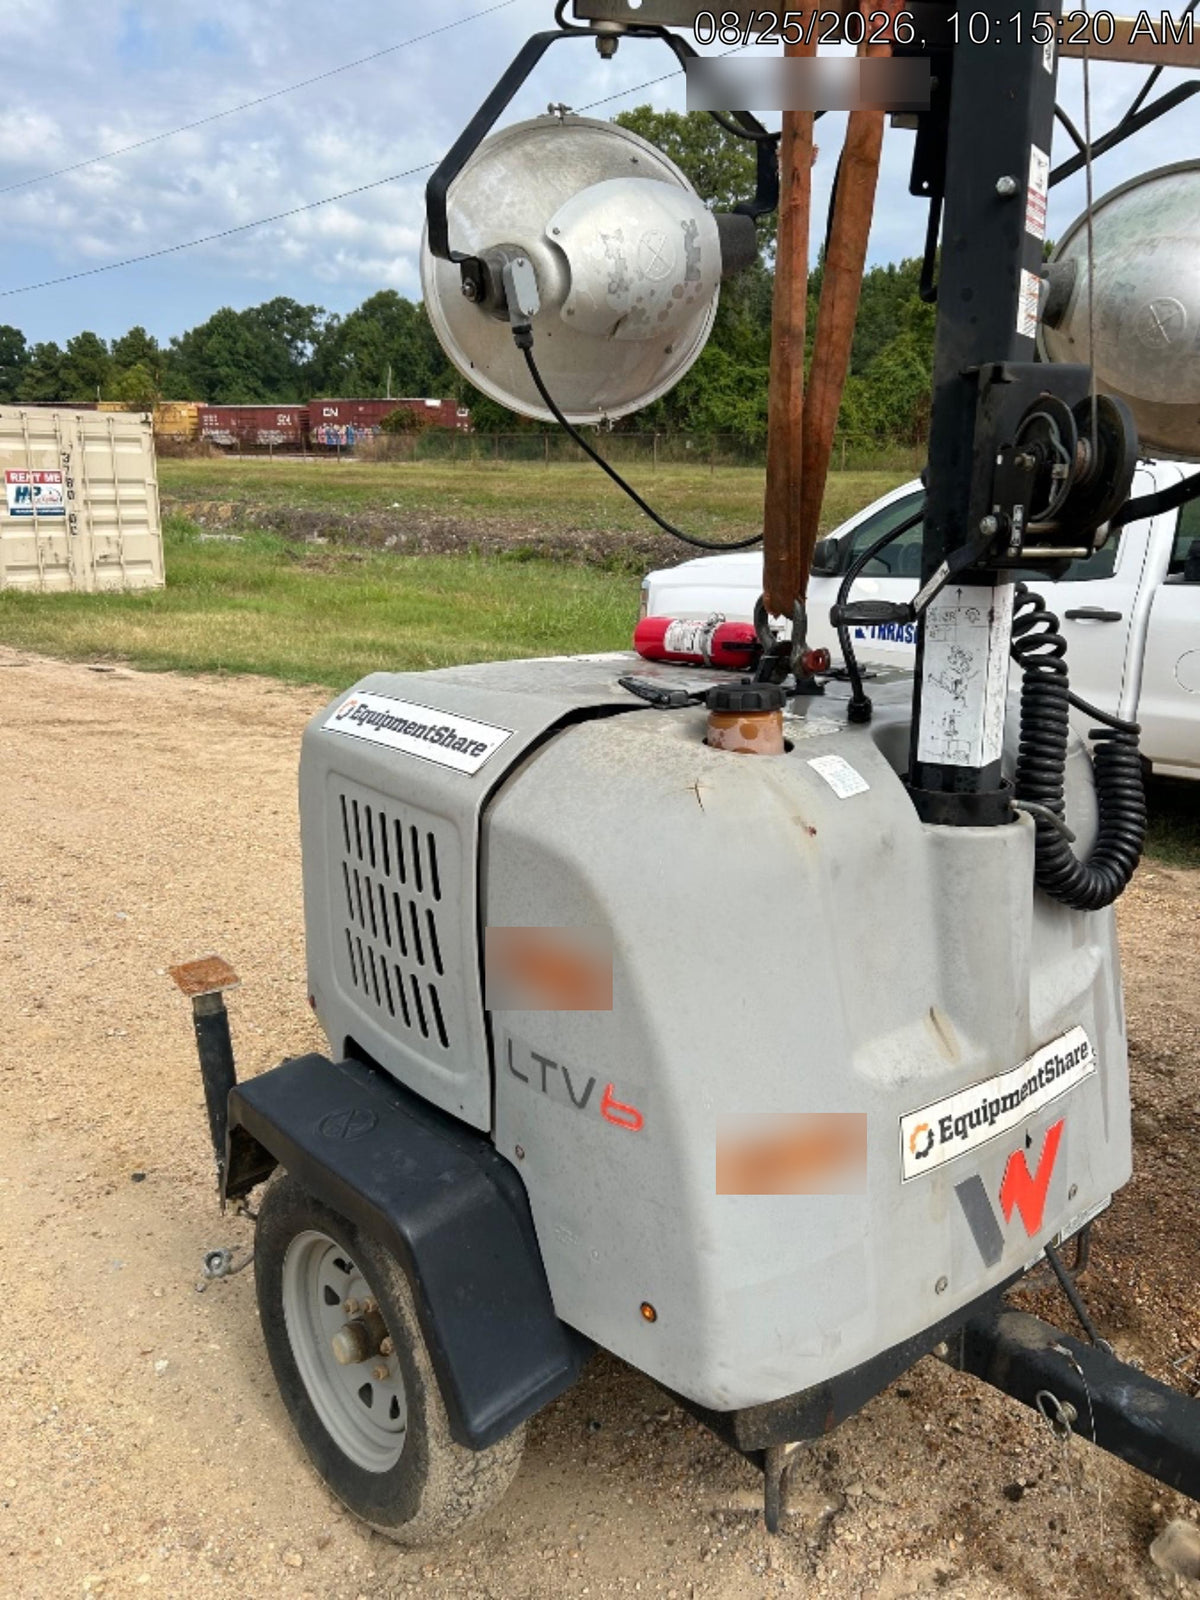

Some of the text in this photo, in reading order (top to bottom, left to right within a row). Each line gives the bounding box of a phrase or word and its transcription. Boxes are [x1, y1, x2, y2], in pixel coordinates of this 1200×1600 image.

[350, 703, 488, 758] EquipmentShare
[507, 1037, 645, 1132] LTV6
[938, 1041, 1089, 1144] EquipmentShare
